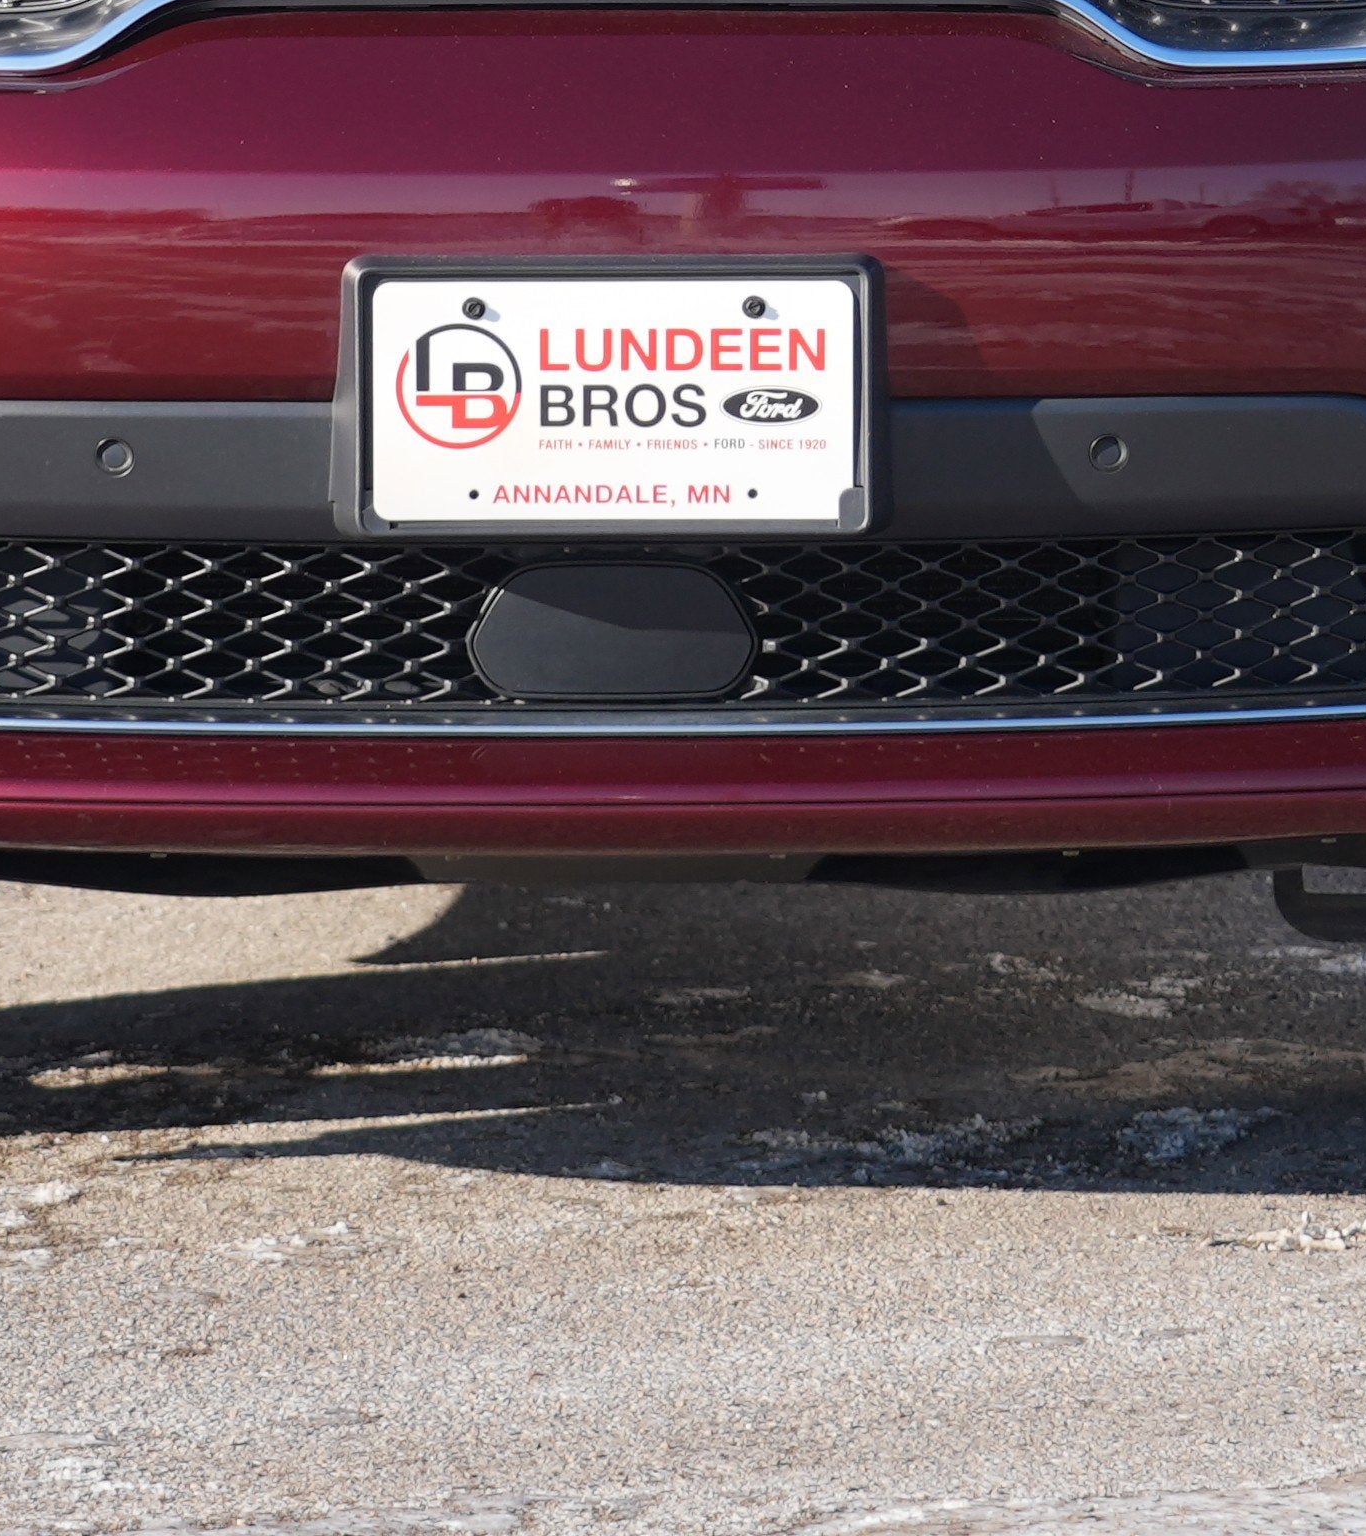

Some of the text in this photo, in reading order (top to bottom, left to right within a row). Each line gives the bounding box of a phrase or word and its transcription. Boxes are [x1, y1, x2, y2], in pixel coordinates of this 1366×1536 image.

[539, 327, 826, 372] LUNDEEN
[539, 383, 707, 428] BROS
[738, 390, 804, 419] Ford
[538, 438, 827, 450] FAITH FAMILY FRIENDS FORD SINCE 1920
[492, 484, 731, 507] ANNANDALE, MN
